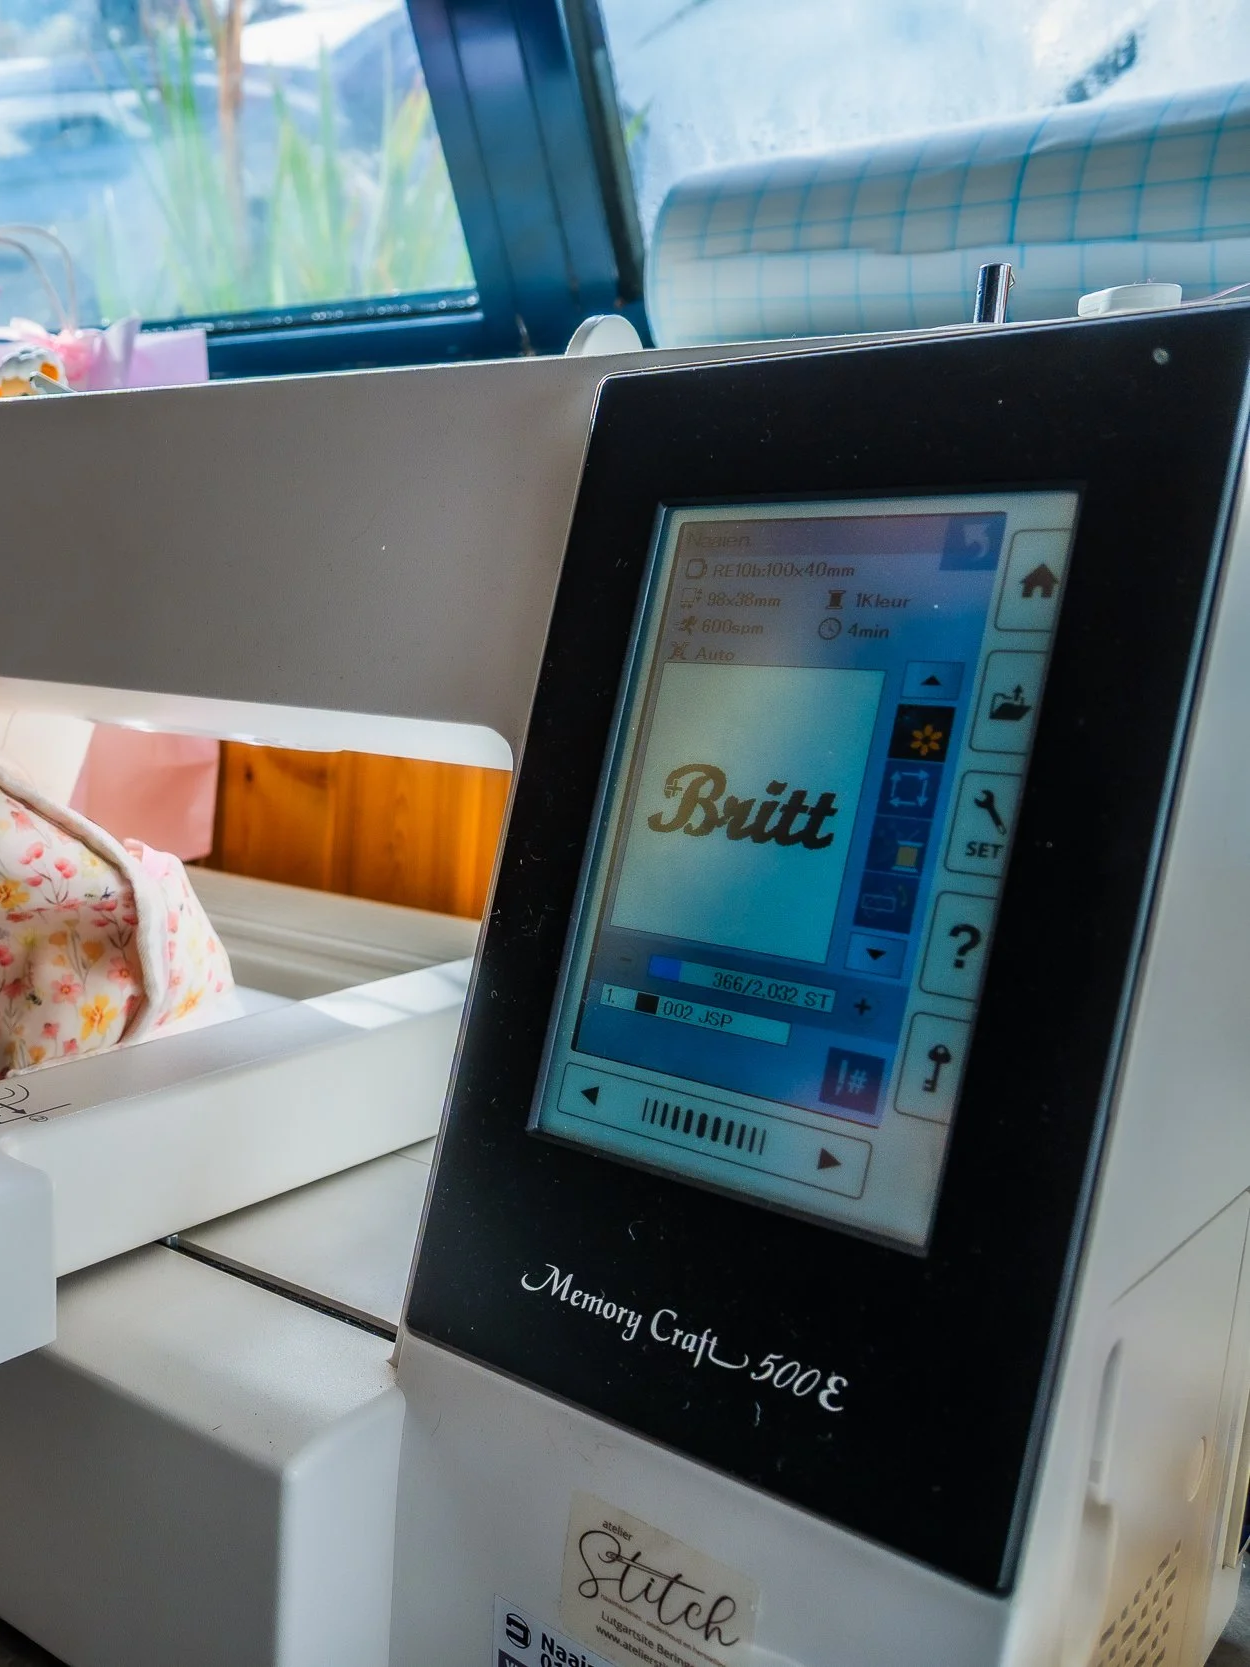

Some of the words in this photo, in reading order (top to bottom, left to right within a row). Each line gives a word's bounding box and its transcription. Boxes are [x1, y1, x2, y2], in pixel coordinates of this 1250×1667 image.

[701, 617, 764, 636] 600spm
[847, 624, 890, 639] 4min
[695, 646, 735, 662] Auto
[647, 763, 838, 850] Britt
[965, 840, 1005, 859] SET
[804, 991, 831, 1010] ST
[662, 1000, 694, 1020] 002
[698, 1010, 734, 1028] JSP
[521, 1263, 642, 1341] Memory
[650, 1308, 749, 1369] Craft
[750, 1353, 849, 1412] 500E
[602, 1520, 634, 1541] atelier
[578, 1529, 739, 1647] Stitch
[601, 1610, 654, 1649] Lutgartsite
[541, 1632, 595, 1667] Naai
